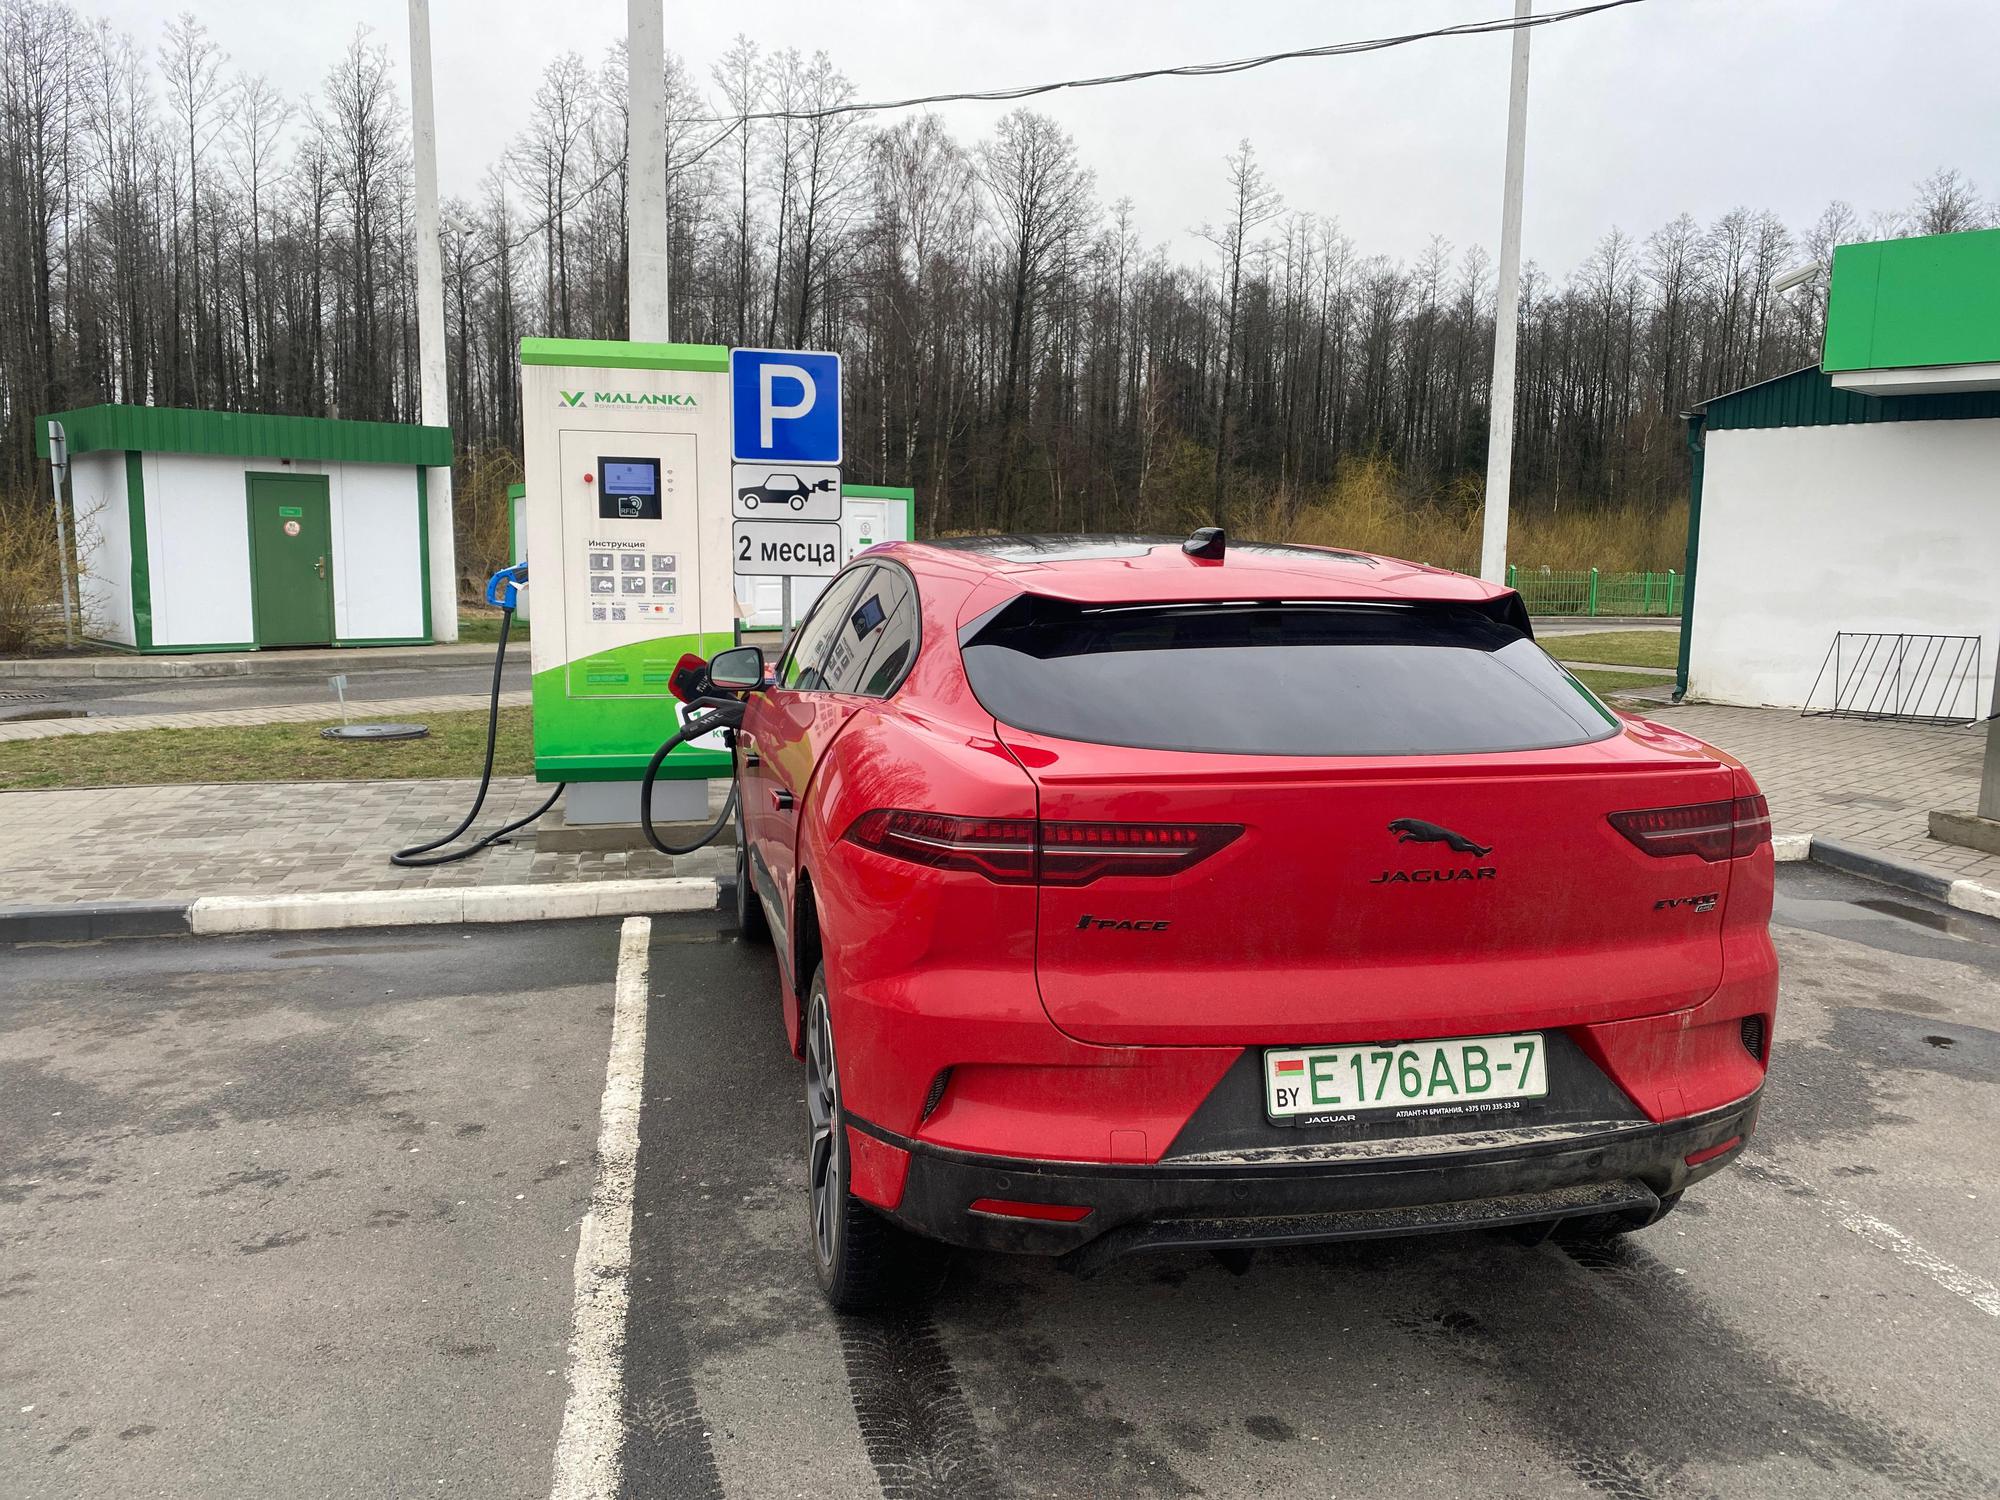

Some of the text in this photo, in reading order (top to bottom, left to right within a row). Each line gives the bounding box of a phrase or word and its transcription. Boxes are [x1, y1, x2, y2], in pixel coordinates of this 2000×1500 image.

[594, 392, 697, 406] MALANKA
[759, 363, 817, 449] P
[588, 539, 645, 549] Инструкция
[738, 535, 836, 567] 2 месца
[1369, 866, 1497, 884] JAGUAR
[1276, 1087, 1300, 1108] BY
[1396, 1101, 1520, 1118] АТЛАНТ-М БРИТАНИЯ, +375 (17) 335-33-33
[1304, 1113, 1357, 1125] JAGUAR
